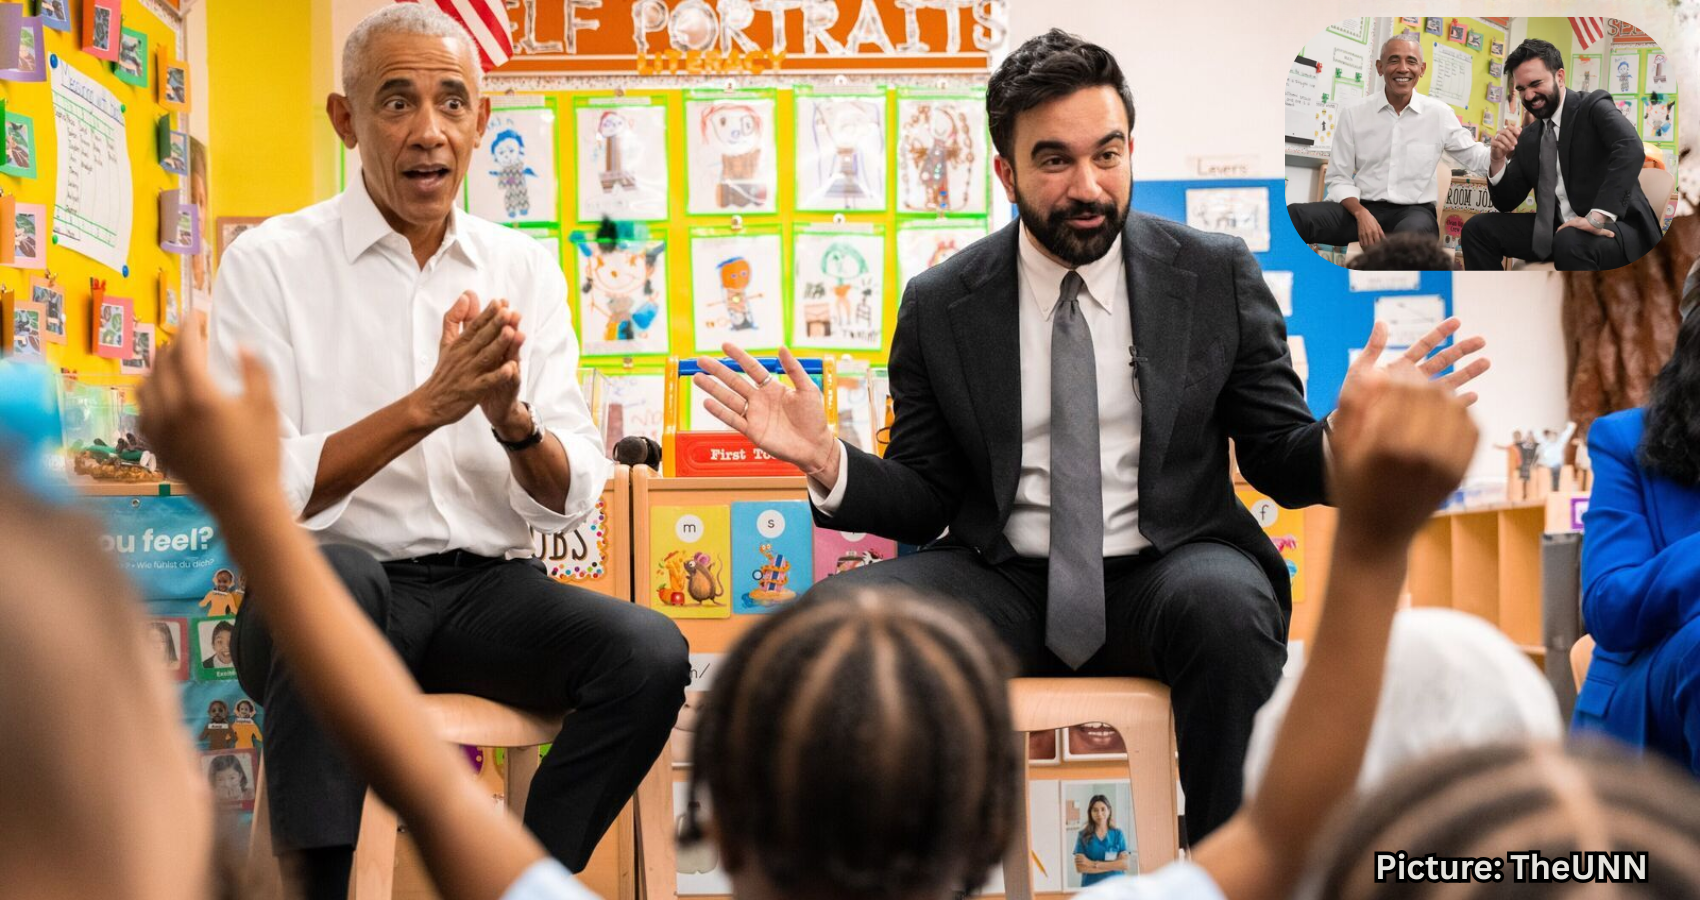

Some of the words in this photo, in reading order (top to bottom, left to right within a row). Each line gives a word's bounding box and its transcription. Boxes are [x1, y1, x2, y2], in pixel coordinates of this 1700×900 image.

[632, 0, 1007, 55] PORTRAITS
[636, 49, 786, 76] LITERACY
[710, 448, 746, 461] First
[1259, 504, 1269, 521] f
[683, 523, 696, 533] m
[767, 518, 775, 529] s
[142, 526, 214, 552] feel?
[179, 560, 191, 568] du
